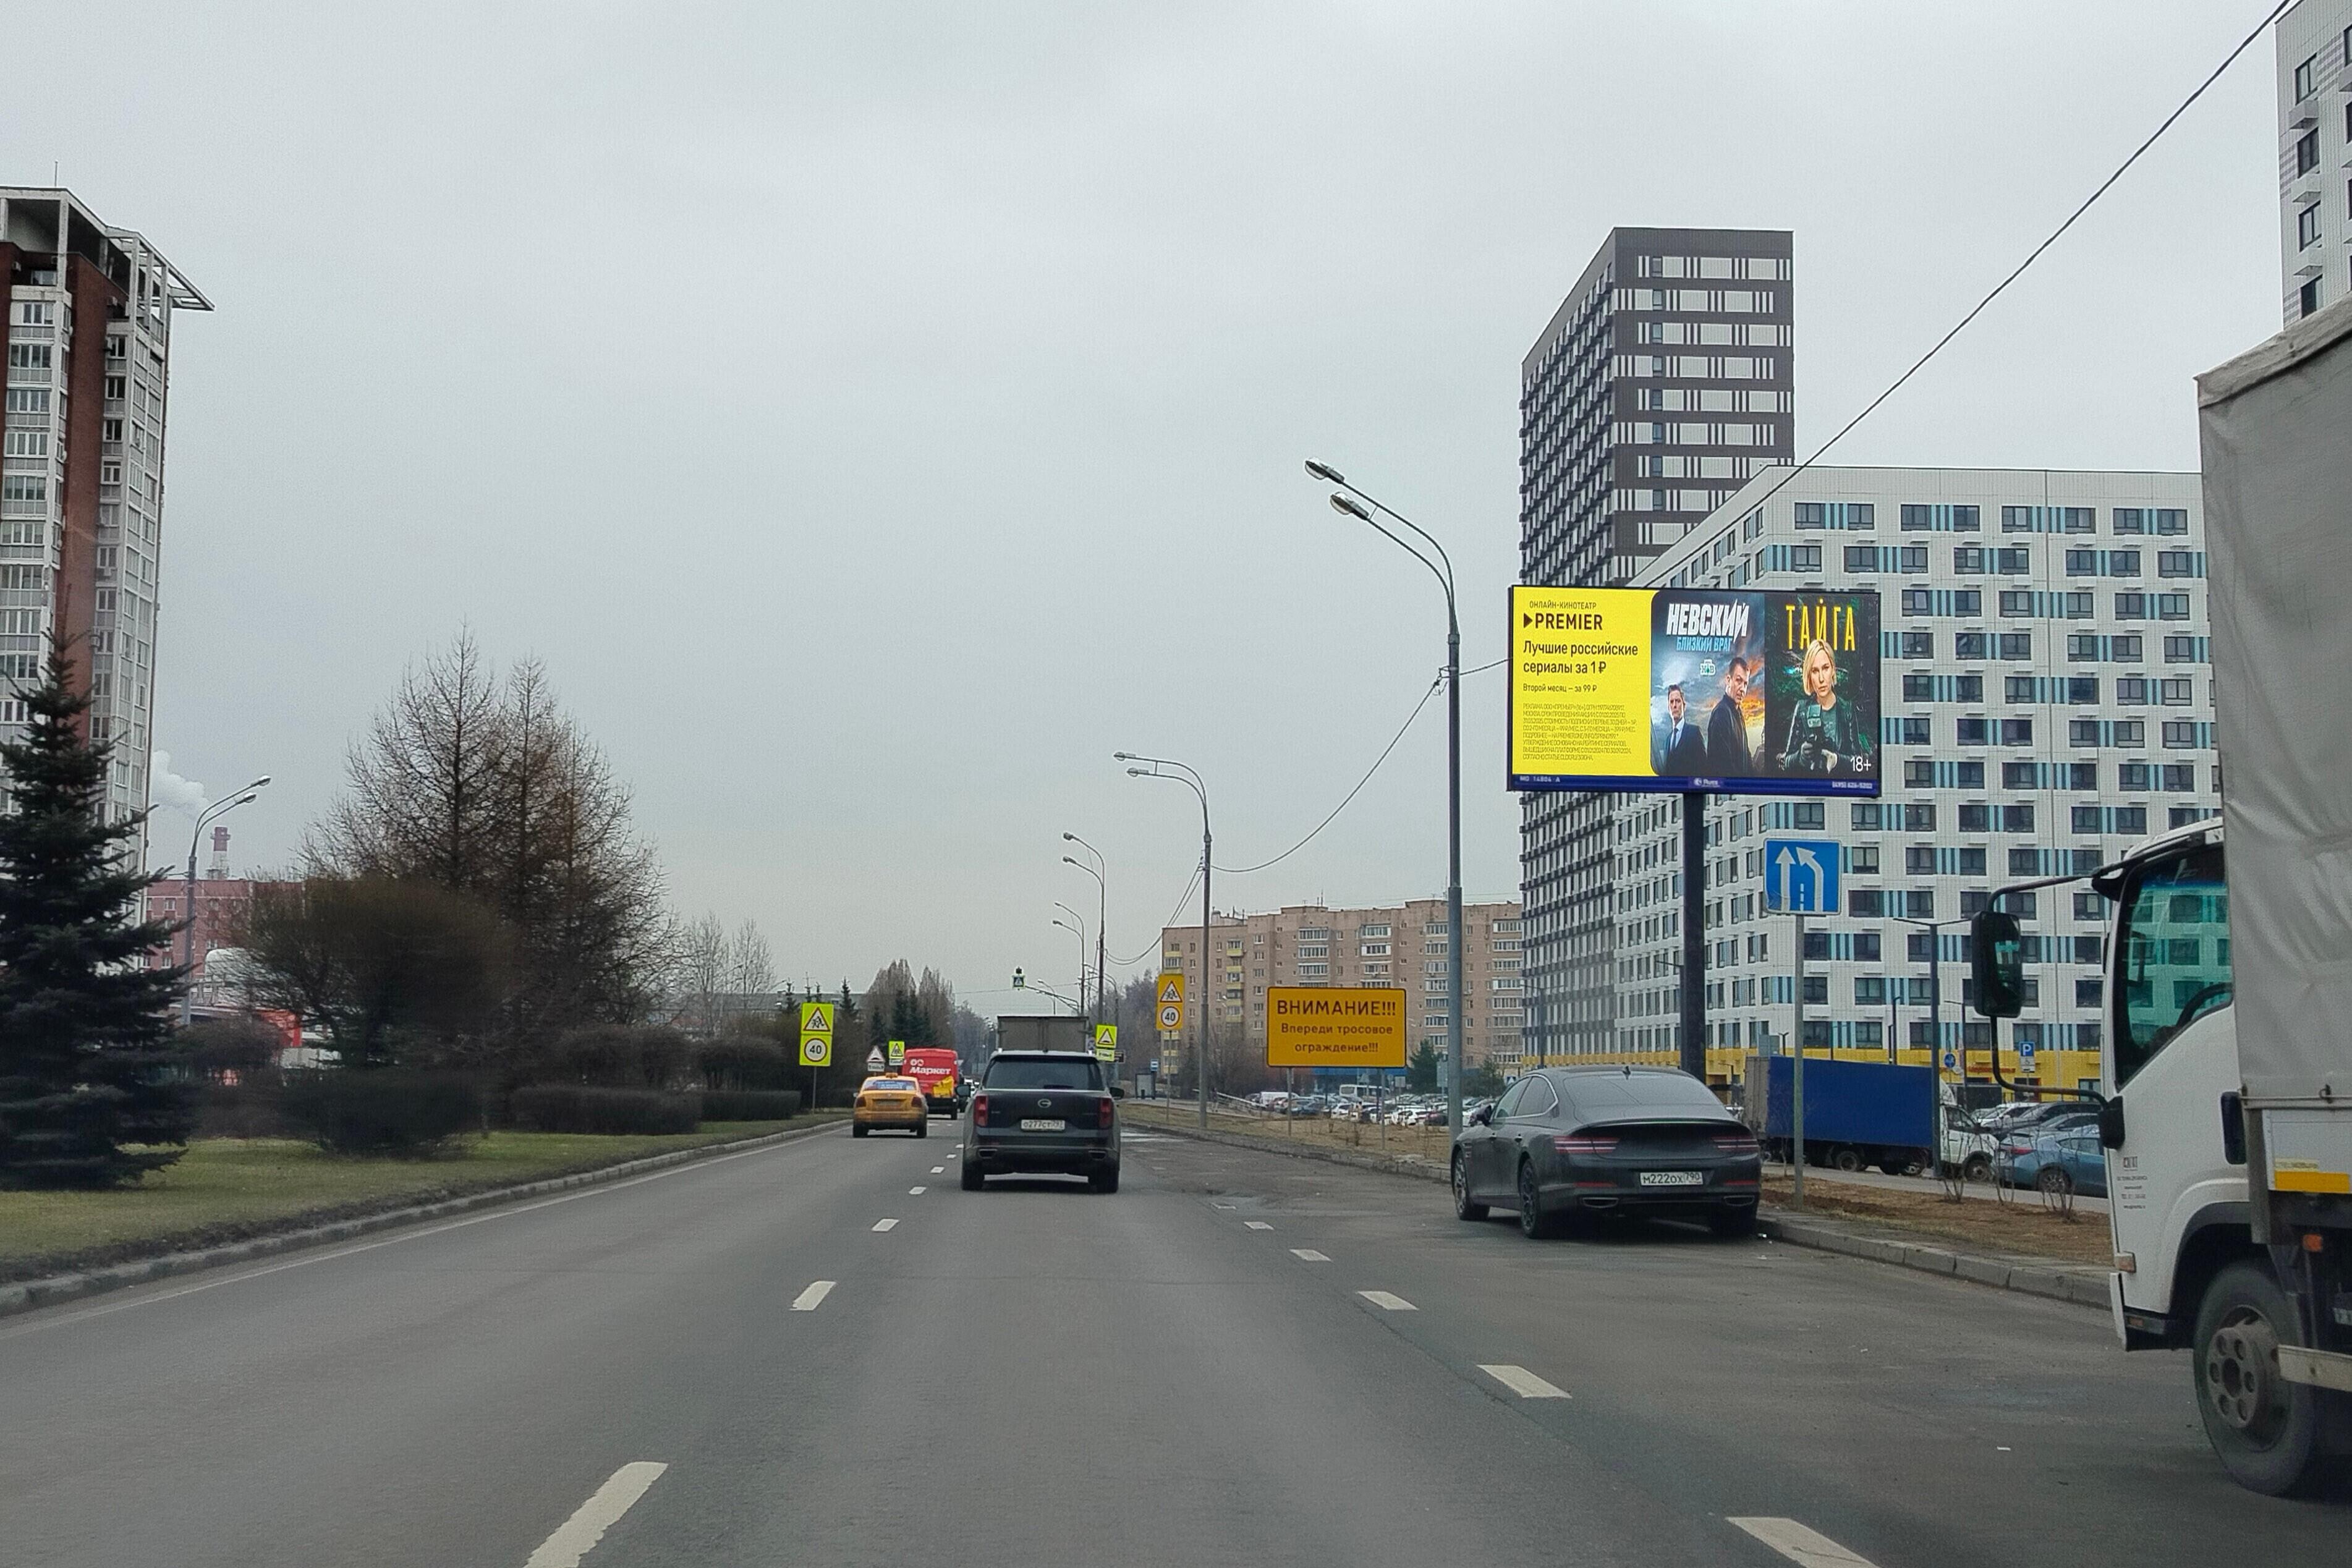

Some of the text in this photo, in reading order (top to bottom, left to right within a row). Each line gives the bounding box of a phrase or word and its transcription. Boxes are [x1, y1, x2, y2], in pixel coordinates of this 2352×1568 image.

[1529, 600, 1597, 609] ОНЛАЙН-КИНОТЕАТР
[1535, 612, 1603, 630] PREMIER
[1666, 598, 1749, 643] НЕВСКИЙ
[1785, 598, 1856, 651] ТАЙГА
[1523, 640, 1639, 658] Лучшие российские
[1523, 662, 1573, 676] сериалы
[1575, 663, 1588, 674] за
[1523, 683, 1546, 693] Второй
[1547, 685, 1567, 693] месяц
[1583, 684, 1591, 692] 99
[1850, 756, 1872, 772] 18+
[1277, 999, 1396, 1016] ВНИМАНИЕ!!!
[1165, 1012, 1176, 1022] 40
[1281, 1023, 1393, 1036] Впереди тросовое
[809, 1045, 822, 1054] 40
[1294, 1043, 1378, 1054] ограждение!!!
[909, 1066, 952, 1075] Маркет
